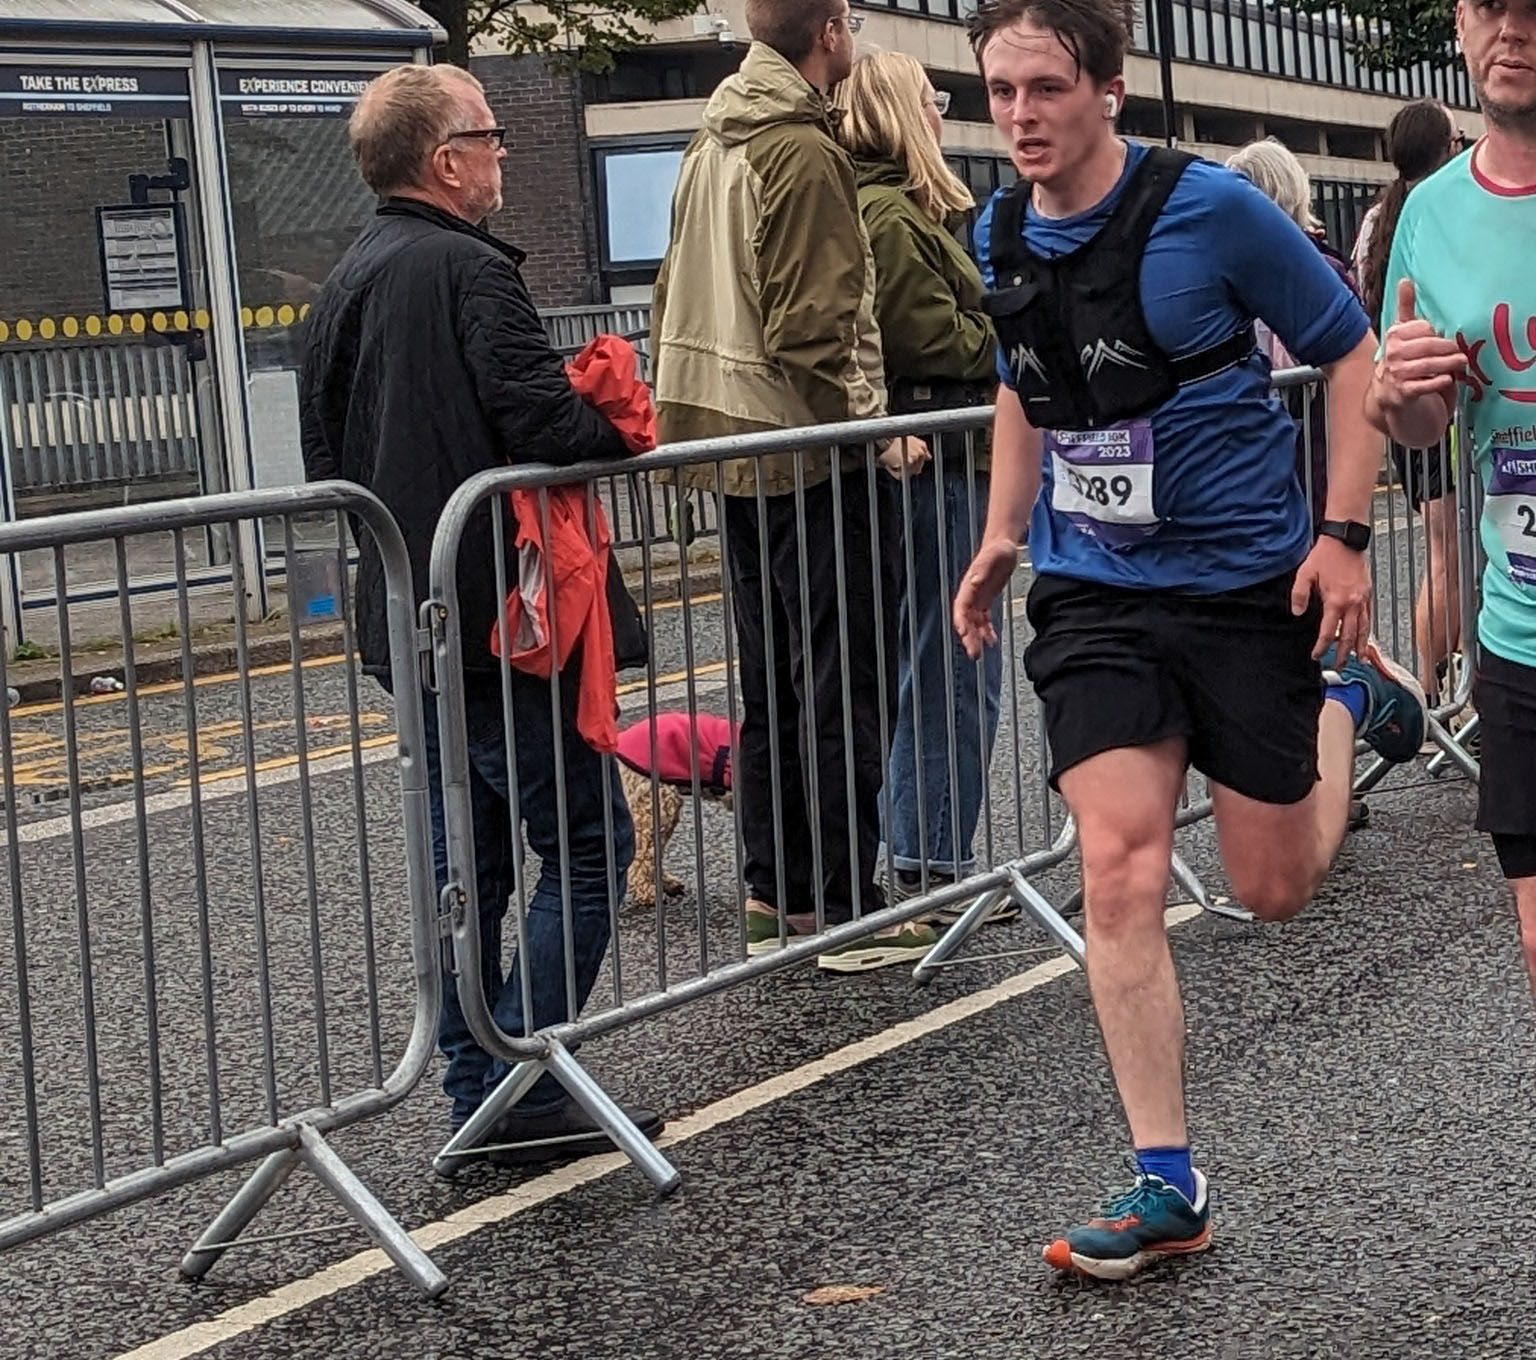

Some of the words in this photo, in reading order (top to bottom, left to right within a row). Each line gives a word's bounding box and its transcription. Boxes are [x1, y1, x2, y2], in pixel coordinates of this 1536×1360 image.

[20, 75, 52, 91] TAKE
[54, 76, 81, 91] THE
[82, 75, 139, 93] EXPRESS
[239, 77, 309, 94] EXPERIENCE
[1097, 445, 1132, 458] 2023
